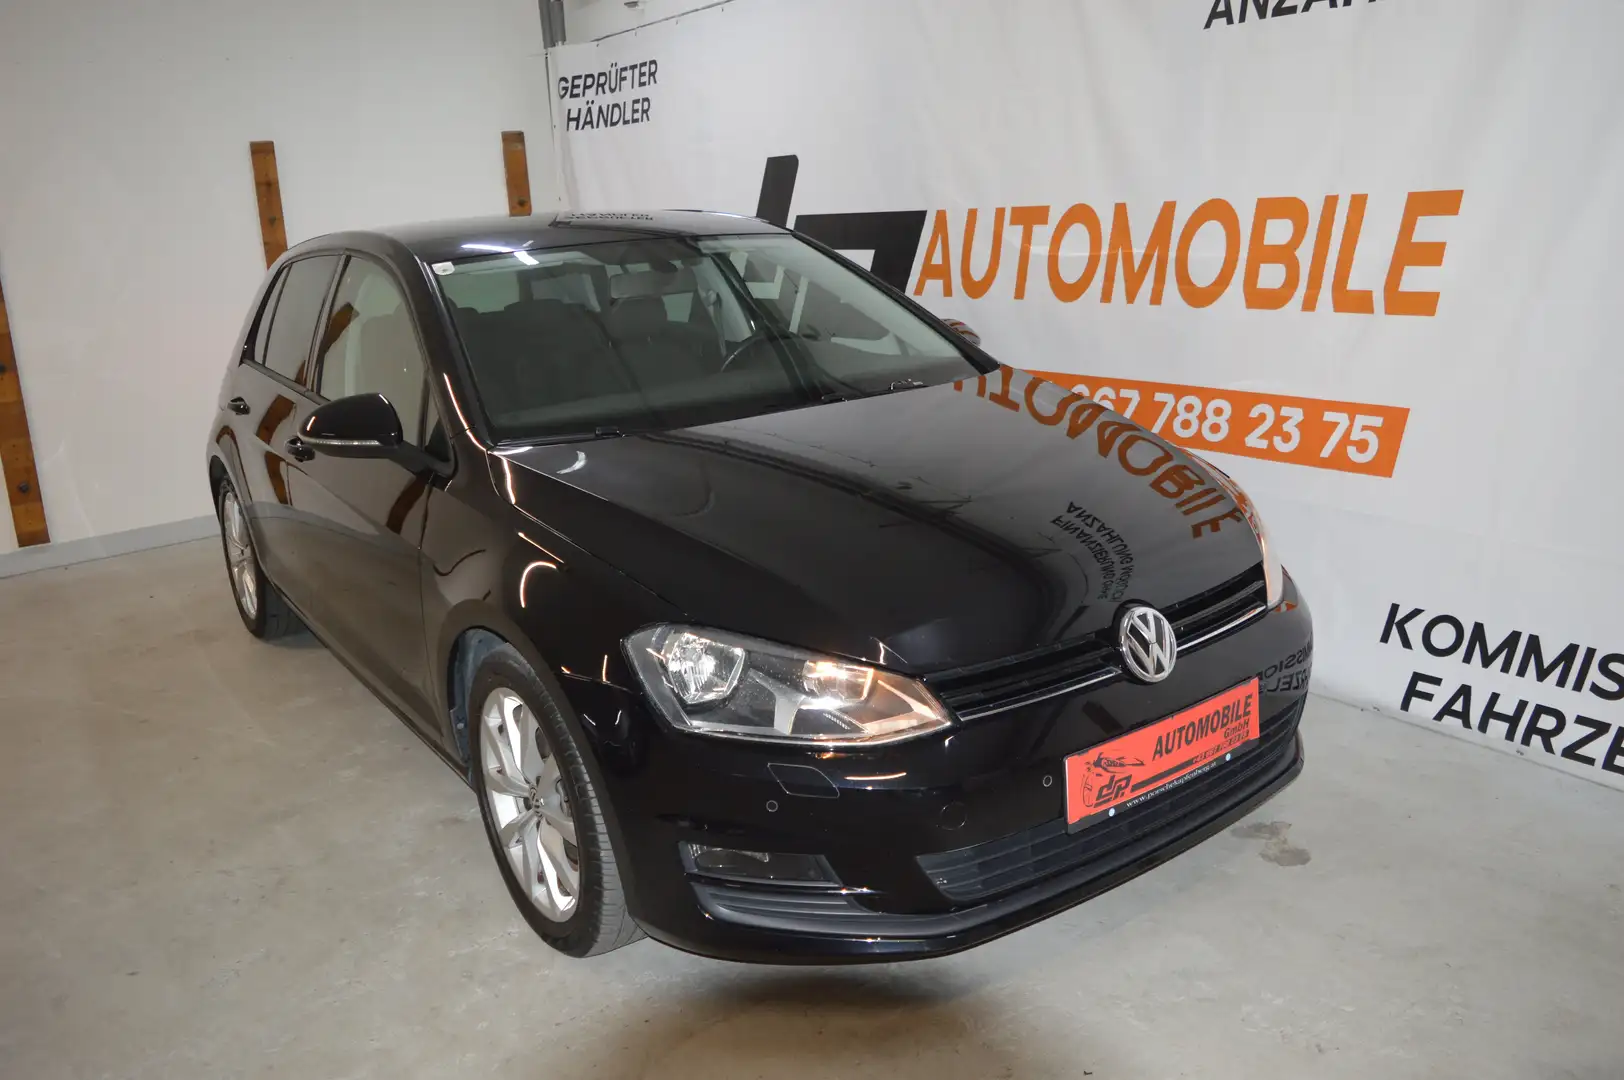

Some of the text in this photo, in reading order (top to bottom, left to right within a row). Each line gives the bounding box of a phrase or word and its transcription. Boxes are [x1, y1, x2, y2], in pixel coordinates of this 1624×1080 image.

[558, 59, 658, 99] GEPRÜFTER
[566, 97, 651, 131] HÄNDLER
[913, 189, 1464, 317] AUTOMOBILE
[1151, 392, 1232, 443] 788
[1245, 403, 1304, 453] 23
[1319, 412, 1384, 464] 75
[1379, 602, 1624, 702] KOMMIS
[1152, 694, 1253, 762] AUTOMOBILE
[1223, 718, 1250, 739] GmbH
